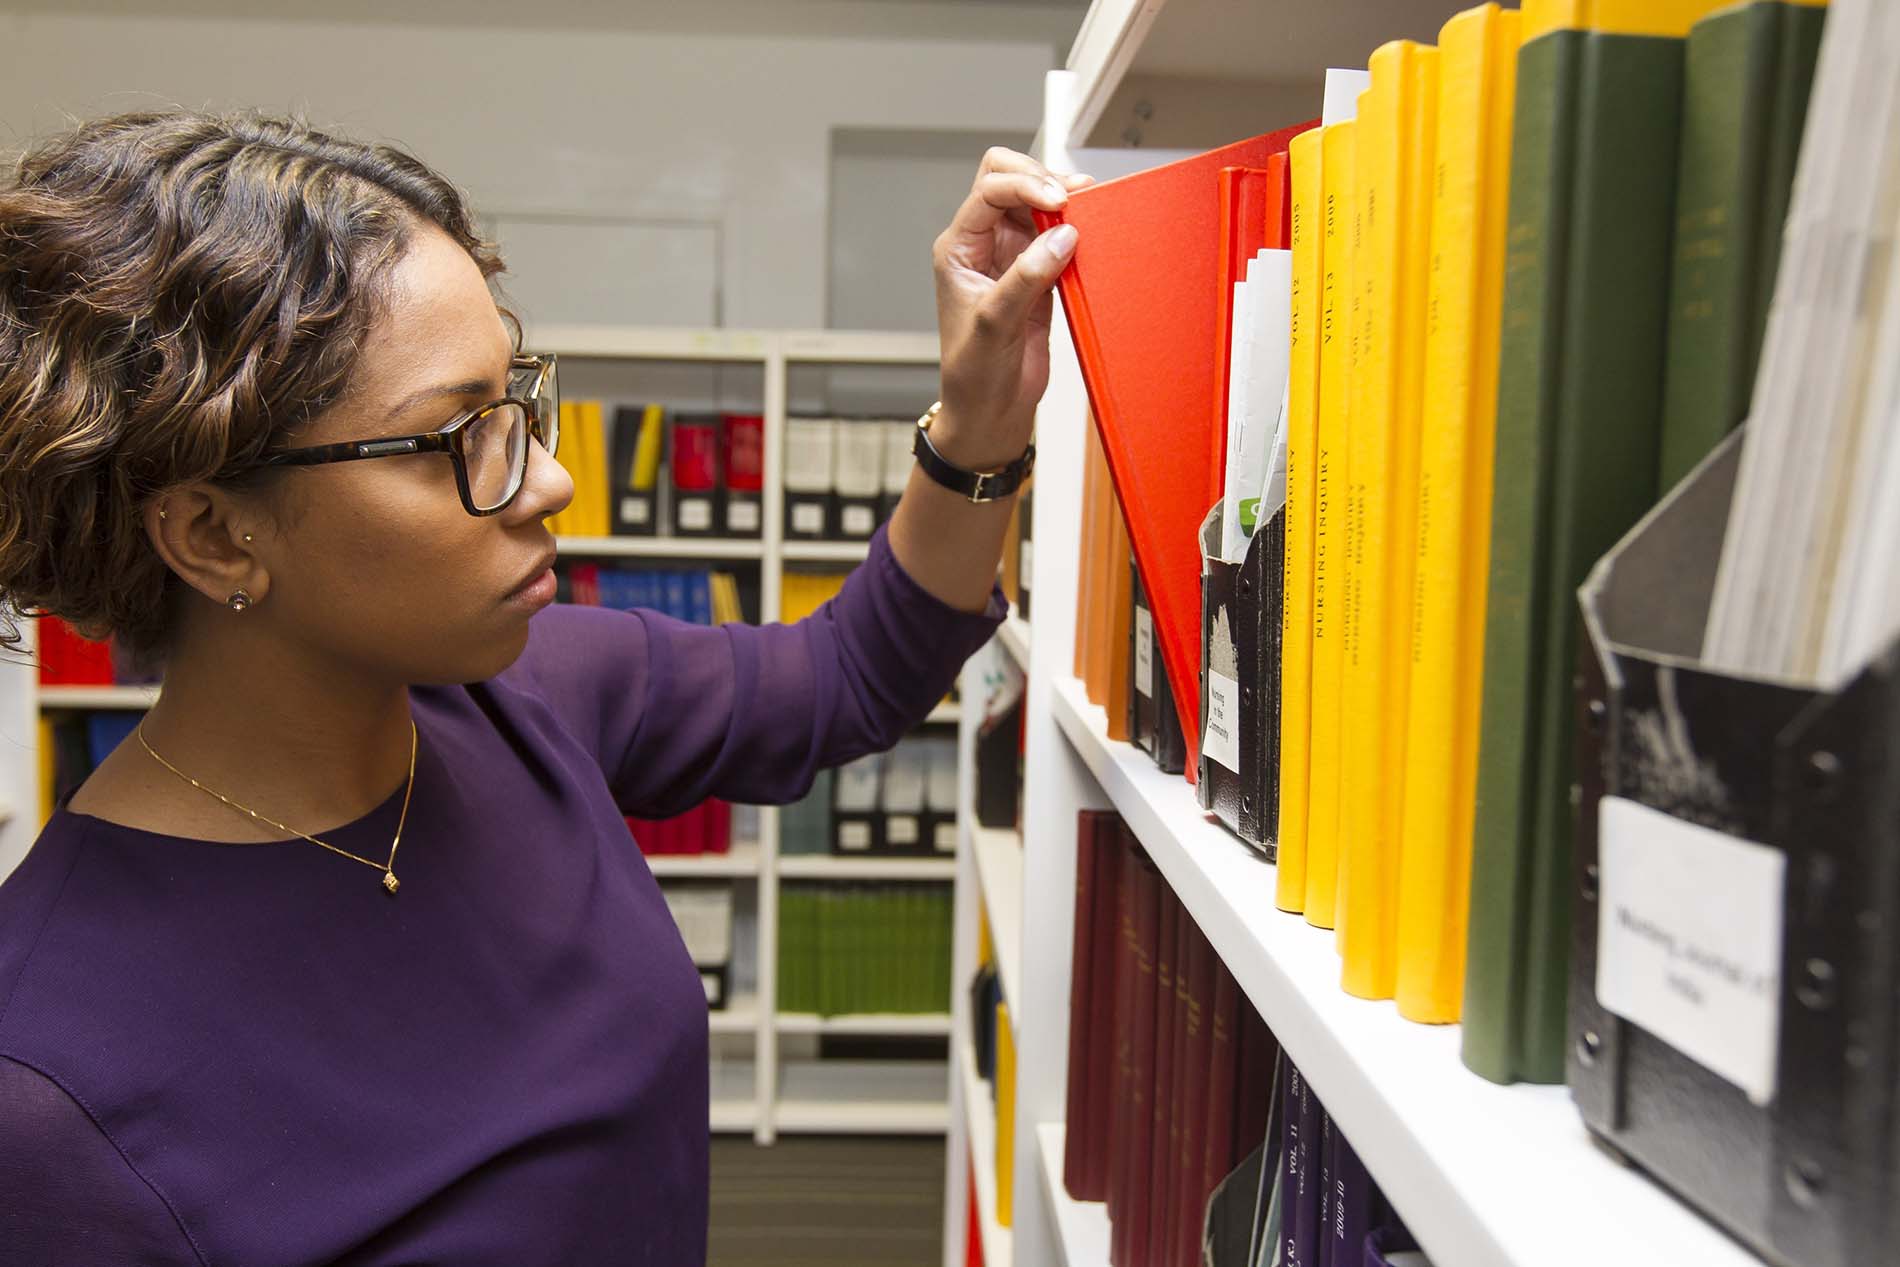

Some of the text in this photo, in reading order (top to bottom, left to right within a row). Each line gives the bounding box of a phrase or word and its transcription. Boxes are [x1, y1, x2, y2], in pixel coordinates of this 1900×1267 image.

[1318, 449, 1328, 536] INQUIRY
[1284, 541, 1292, 630] NURSING
[1317, 545, 1326, 637] NURSING
[1291, 1124, 1297, 1138] 11
[1336, 1180, 1345, 1240] 2009-10
